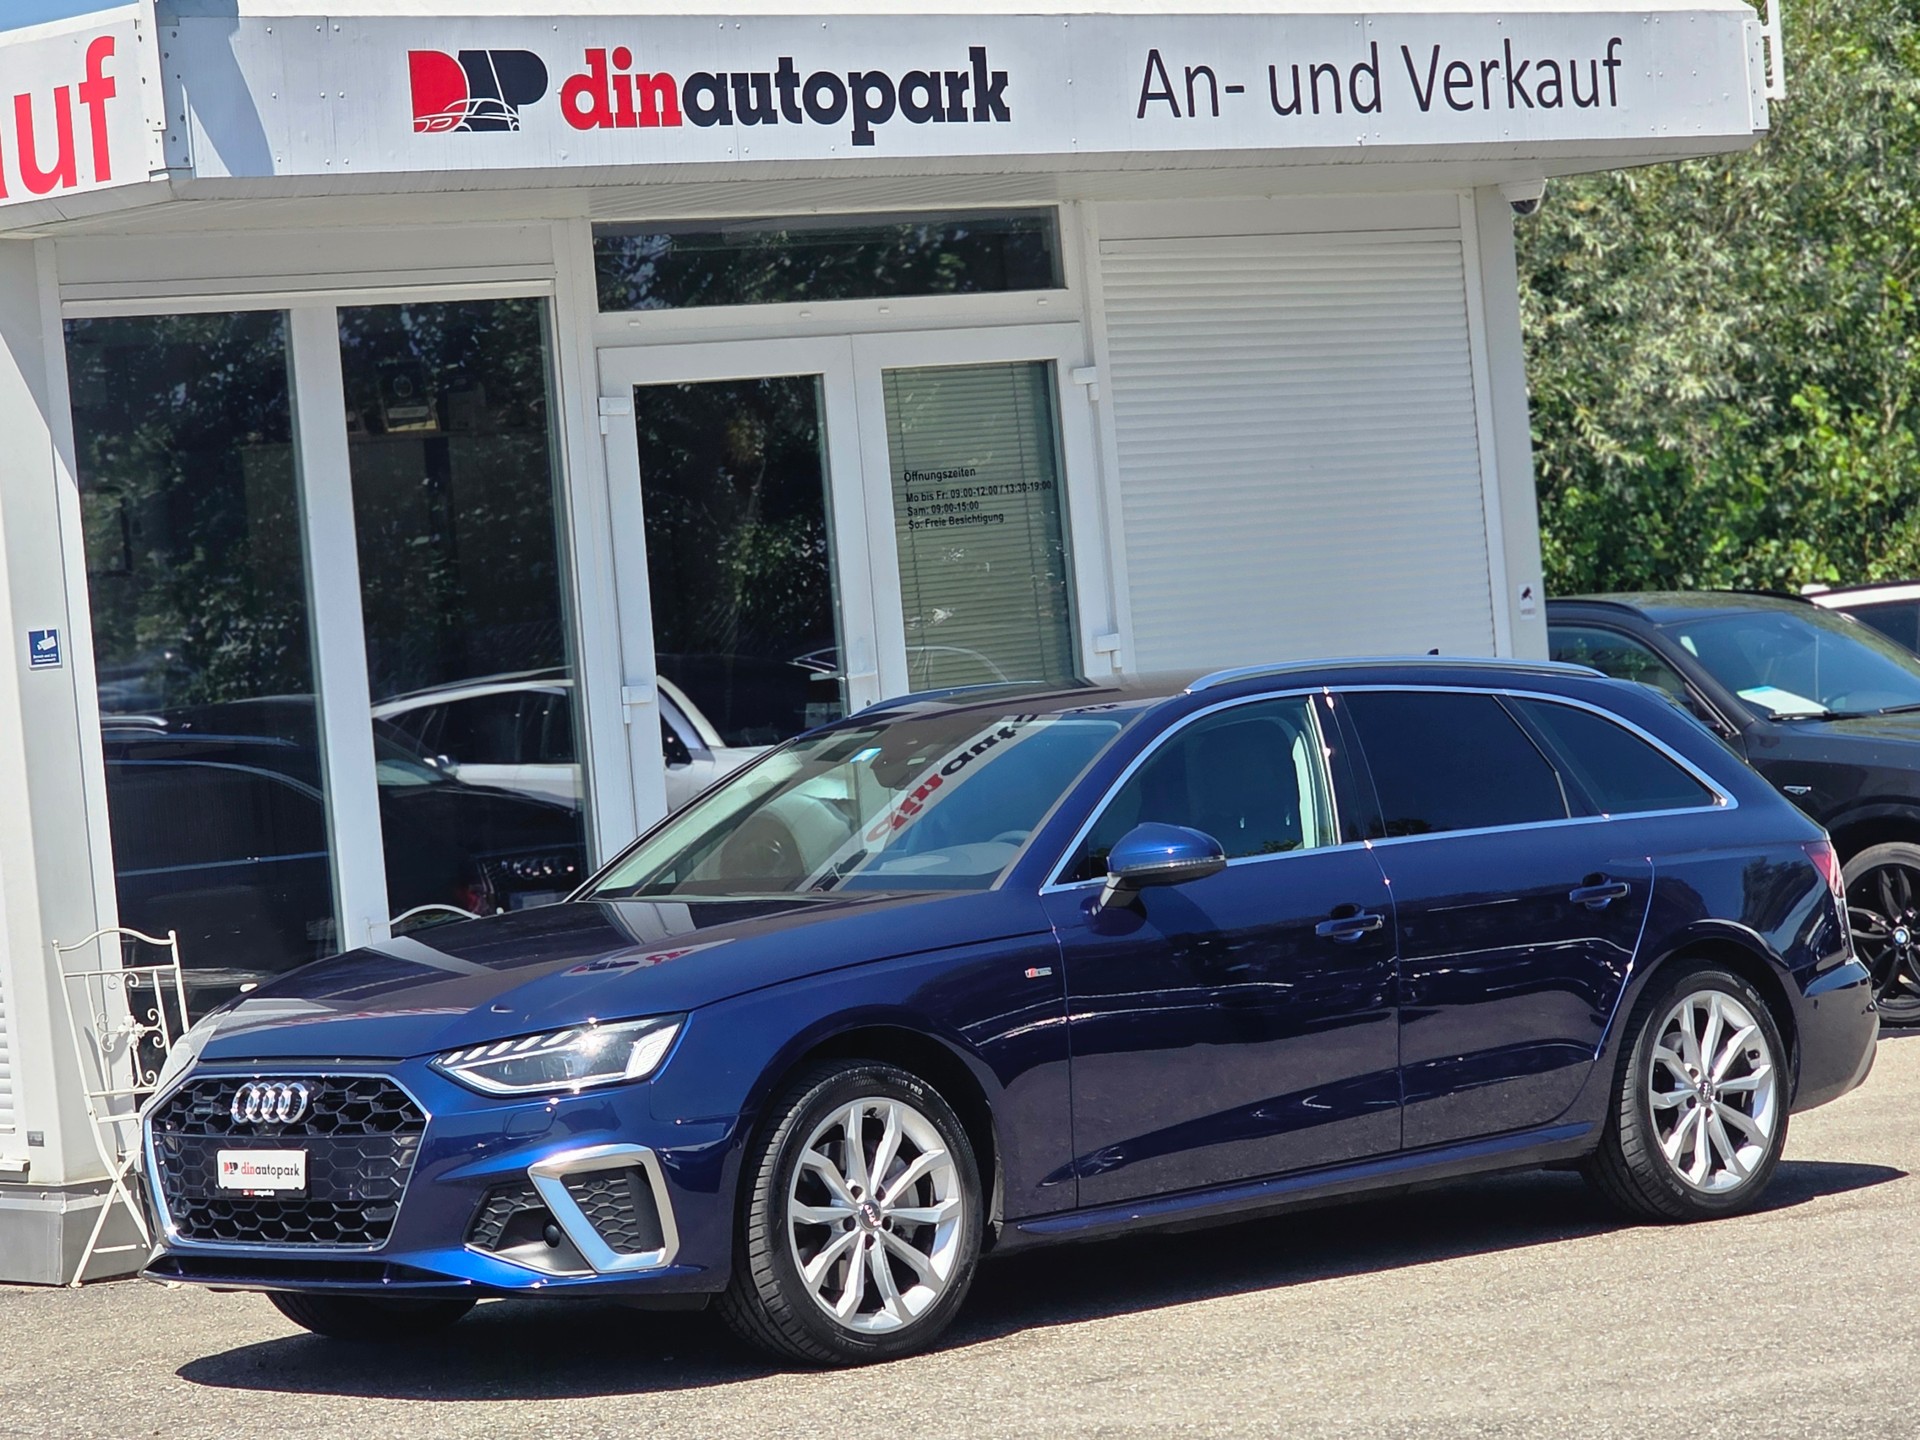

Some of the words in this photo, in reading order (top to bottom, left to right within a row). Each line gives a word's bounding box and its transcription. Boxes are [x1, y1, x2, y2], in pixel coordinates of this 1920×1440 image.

[560, 46, 1011, 146] dinautopark
[1137, 48, 1245, 119] An-
[1268, 41, 1382, 116] und
[1401, 37, 1622, 112] Verkauf
[0, 35, 116, 198] uf
[906, 493, 919, 503] Mo
[921, 491, 934, 502] bis
[925, 516, 947, 528] Freie
[948, 512, 1004, 525] Besichtigung
[241, 1161, 300, 1180] dinautopark
